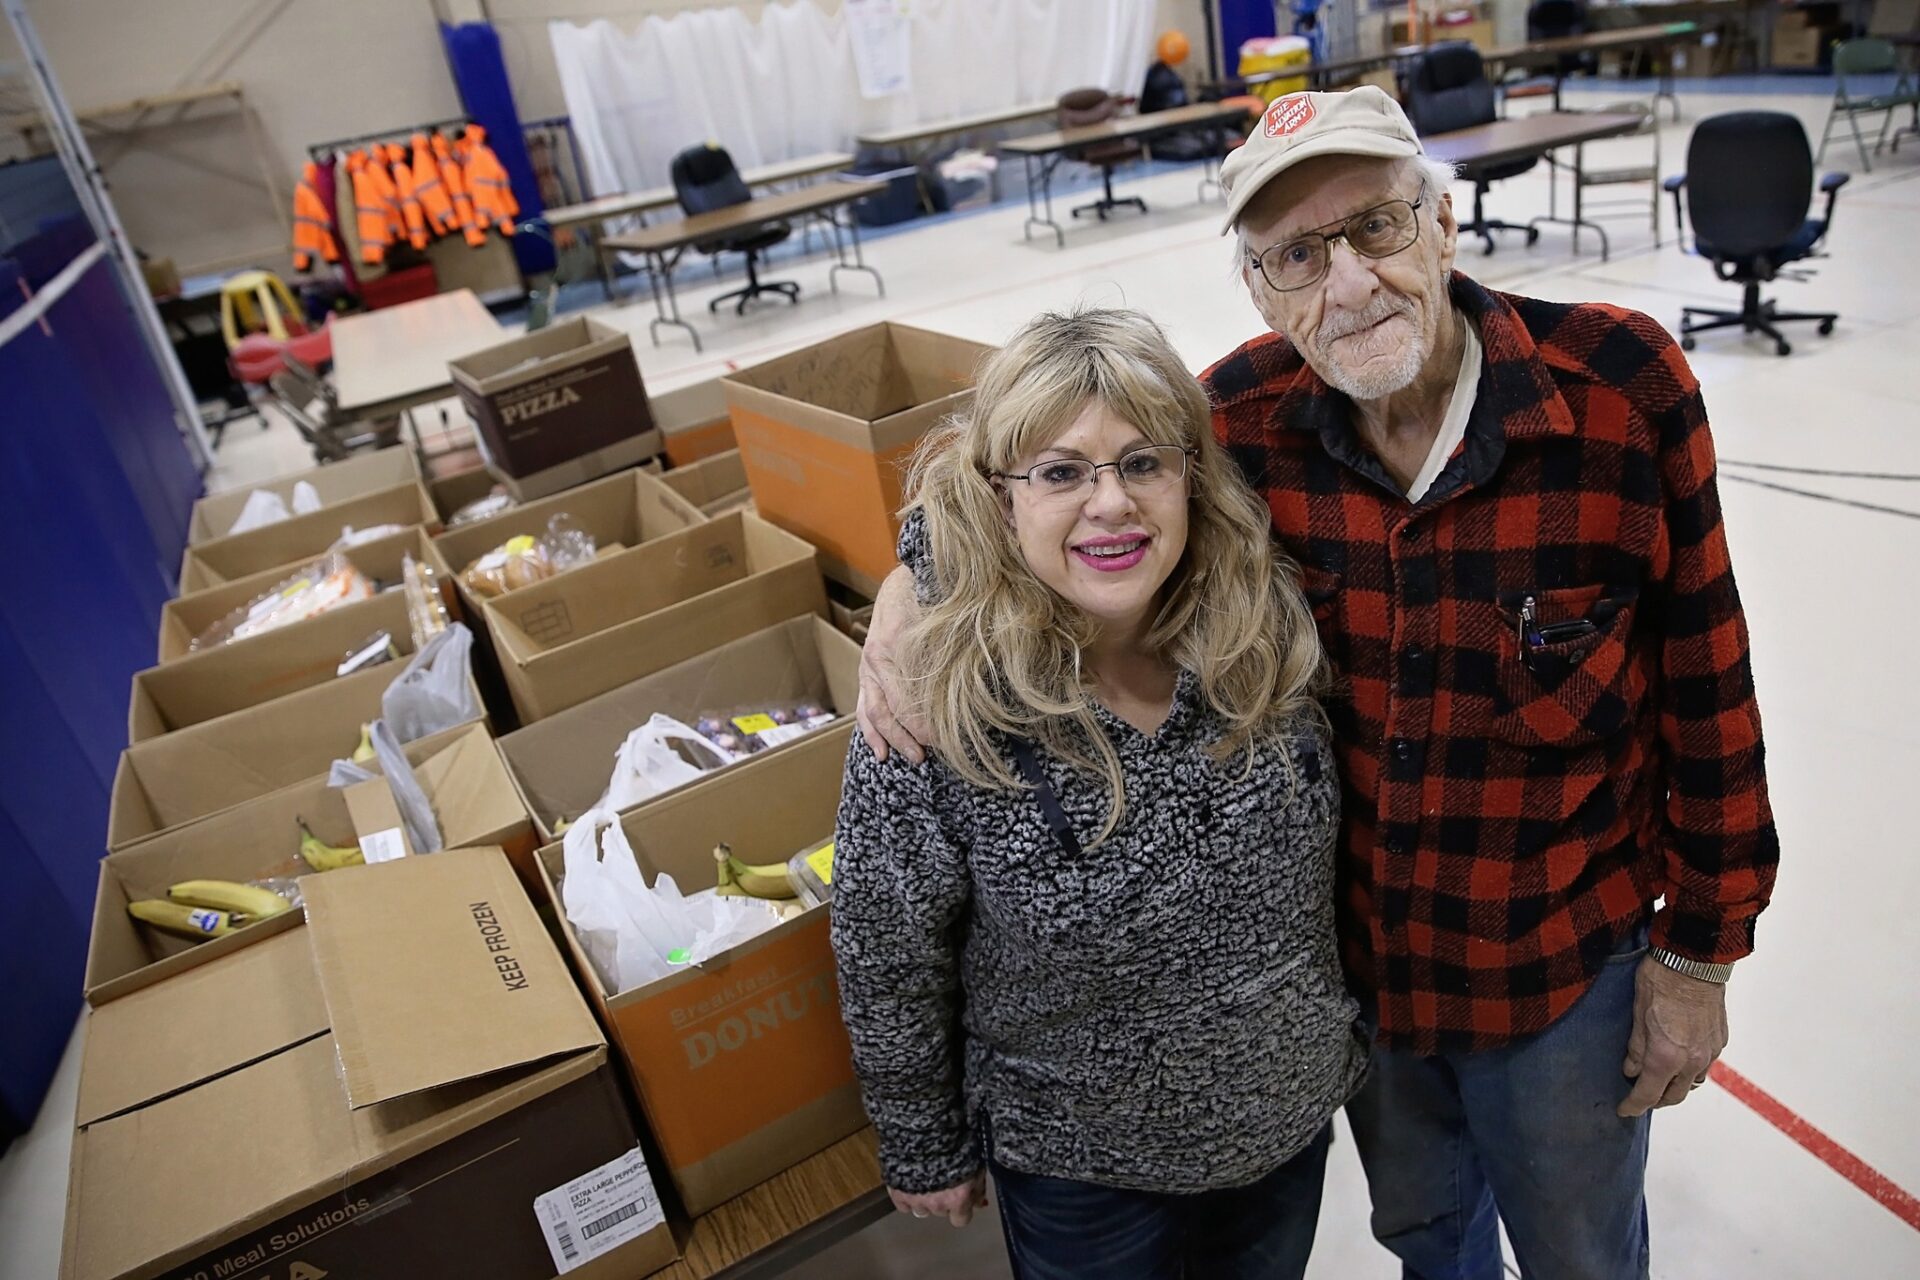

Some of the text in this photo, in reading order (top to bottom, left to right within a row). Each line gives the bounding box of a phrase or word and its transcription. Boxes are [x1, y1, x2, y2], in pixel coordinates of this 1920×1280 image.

[1268, 97, 1308, 135] SALVATION
[1271, 102, 1290, 119] THE
[1285, 107, 1308, 132] ARMY
[500, 386, 581, 425] PIZZA
[469, 901, 529, 991] KEEP FROZEN
[671, 966, 780, 1025] Breakfast
[570, 1187, 592, 1203] EXTRA
[592, 1177, 614, 1193] LARGE
[573, 1197, 592, 1210] PIZZA
[213, 1243, 266, 1278] Meal
[269, 1198, 370, 1251] Solutions
